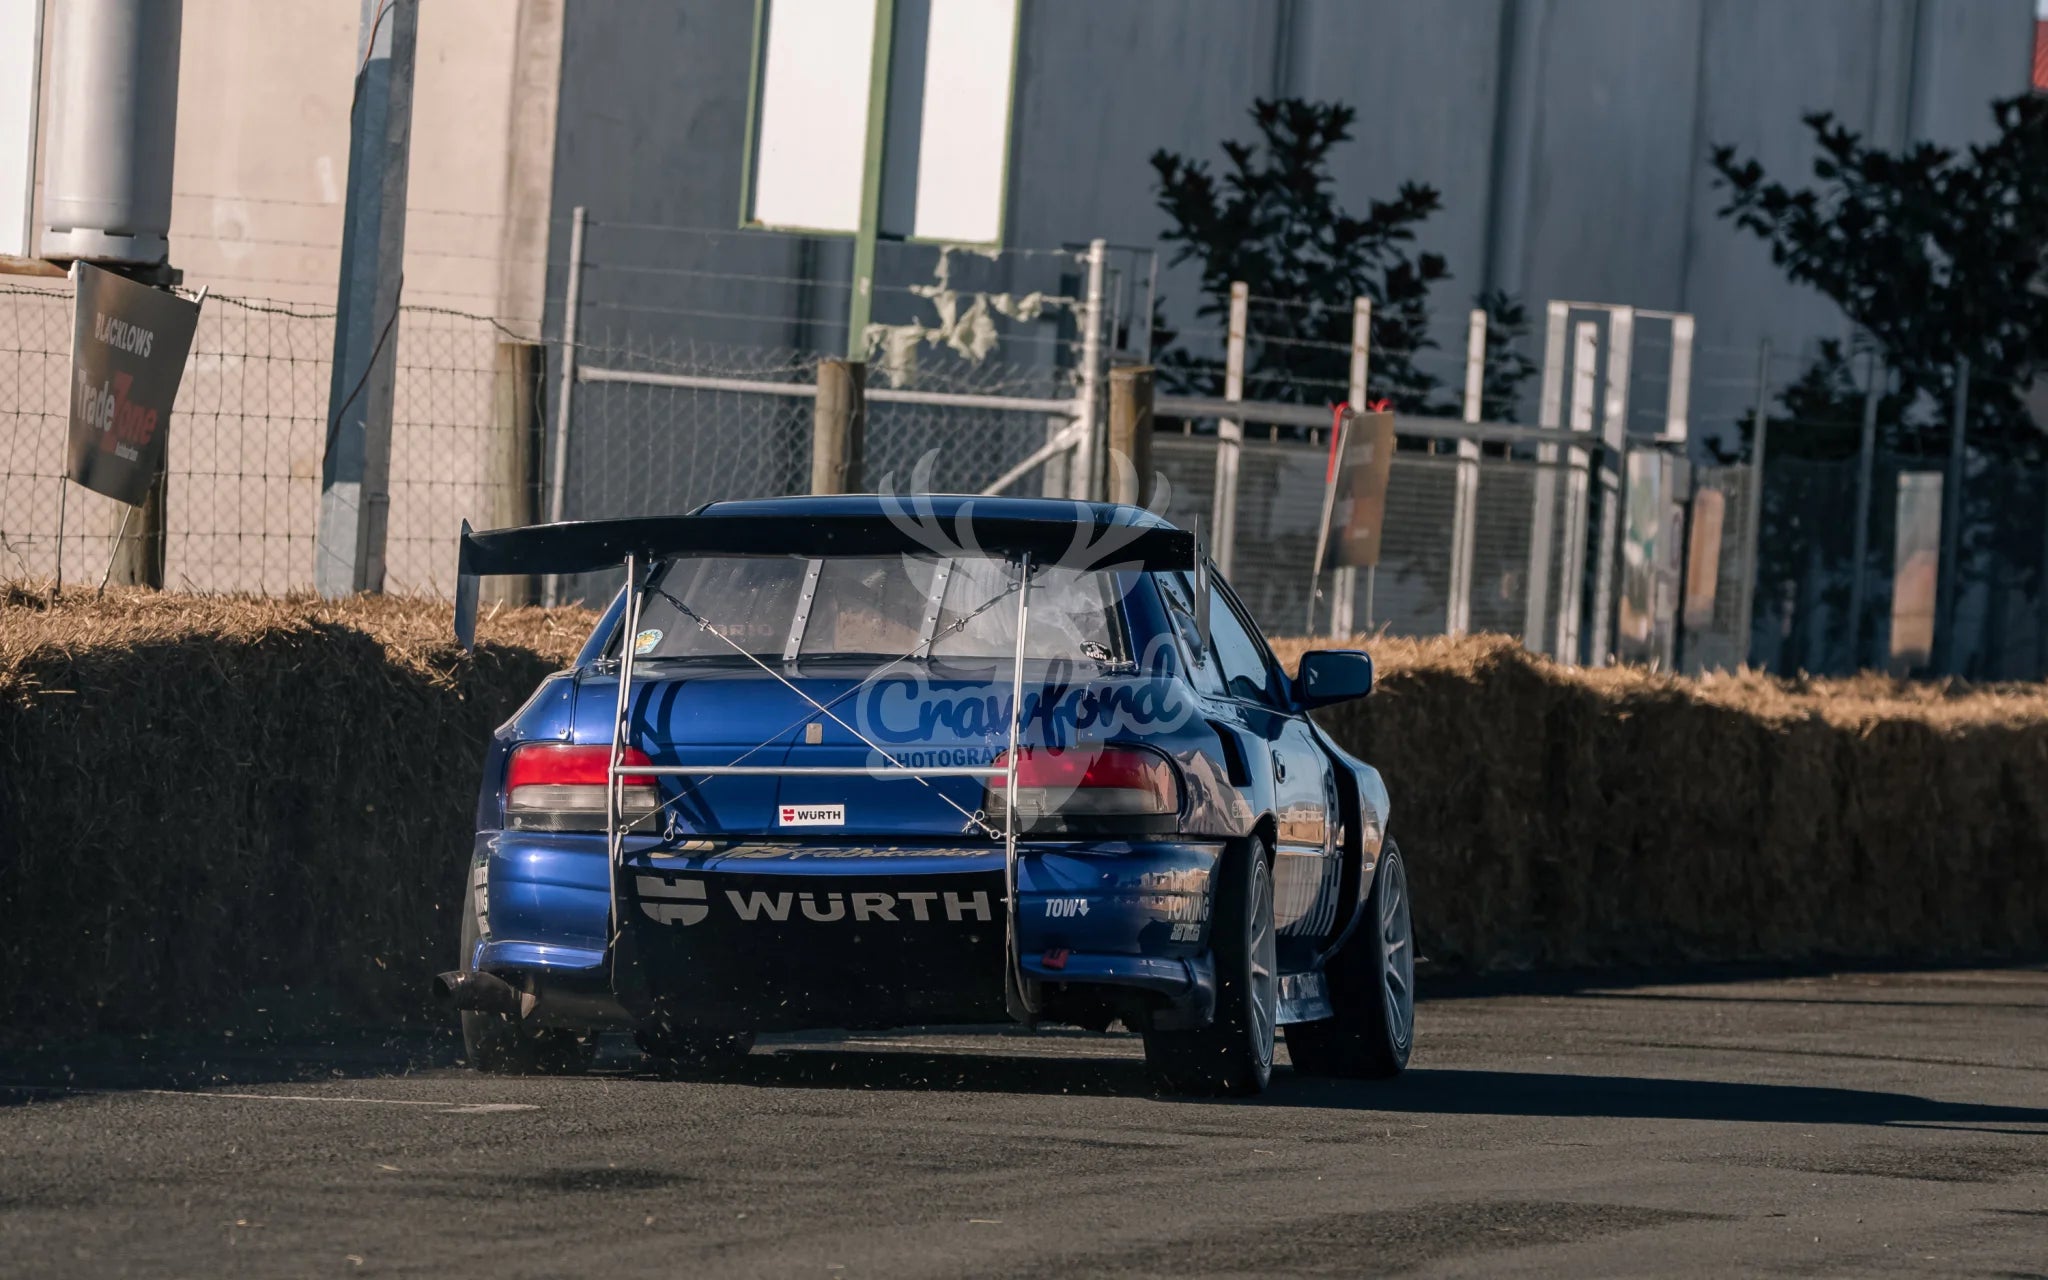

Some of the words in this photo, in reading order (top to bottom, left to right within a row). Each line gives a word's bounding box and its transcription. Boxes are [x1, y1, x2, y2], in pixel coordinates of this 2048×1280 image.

[95, 312, 154, 358] BLACKLOWS
[797, 810, 841, 821] WÜRTH
[724, 890, 992, 923] WÜRTH
[1045, 899, 1078, 917] TOW
[1168, 895, 1209, 921] TOWING
